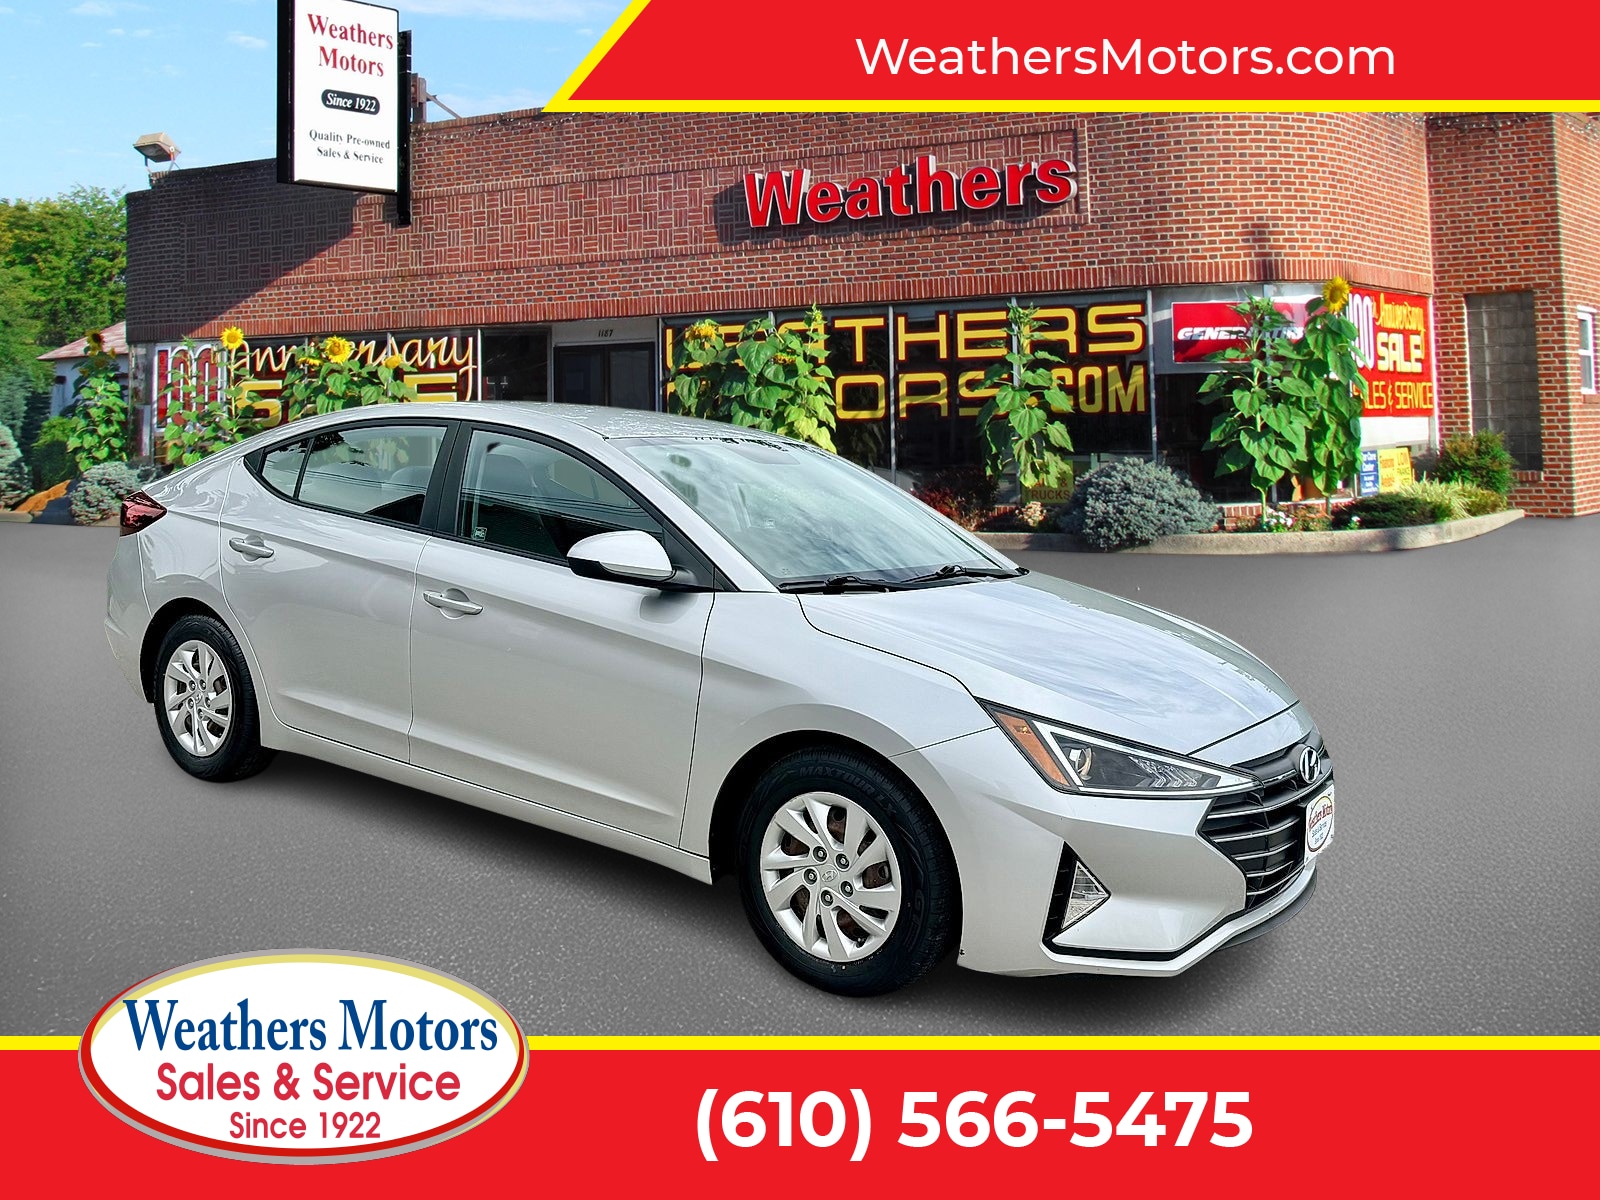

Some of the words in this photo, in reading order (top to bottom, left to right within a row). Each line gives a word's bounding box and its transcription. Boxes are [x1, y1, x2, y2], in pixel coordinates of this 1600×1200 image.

[307, 13, 394, 50] Weathers
[319, 46, 384, 77] Motors
[326, 92, 353, 109] Since
[354, 97, 376, 112] 1922
[309, 129, 343, 146] Quality
[346, 134, 390, 150] Pre-owned
[317, 146, 341, 159] Sales
[343, 150, 350, 160] &
[353, 152, 384, 165] Service
[743, 154, 1078, 228] Weathers
[1377, 331, 1423, 373] SALE
[1394, 381, 1434, 409] SERVICE
